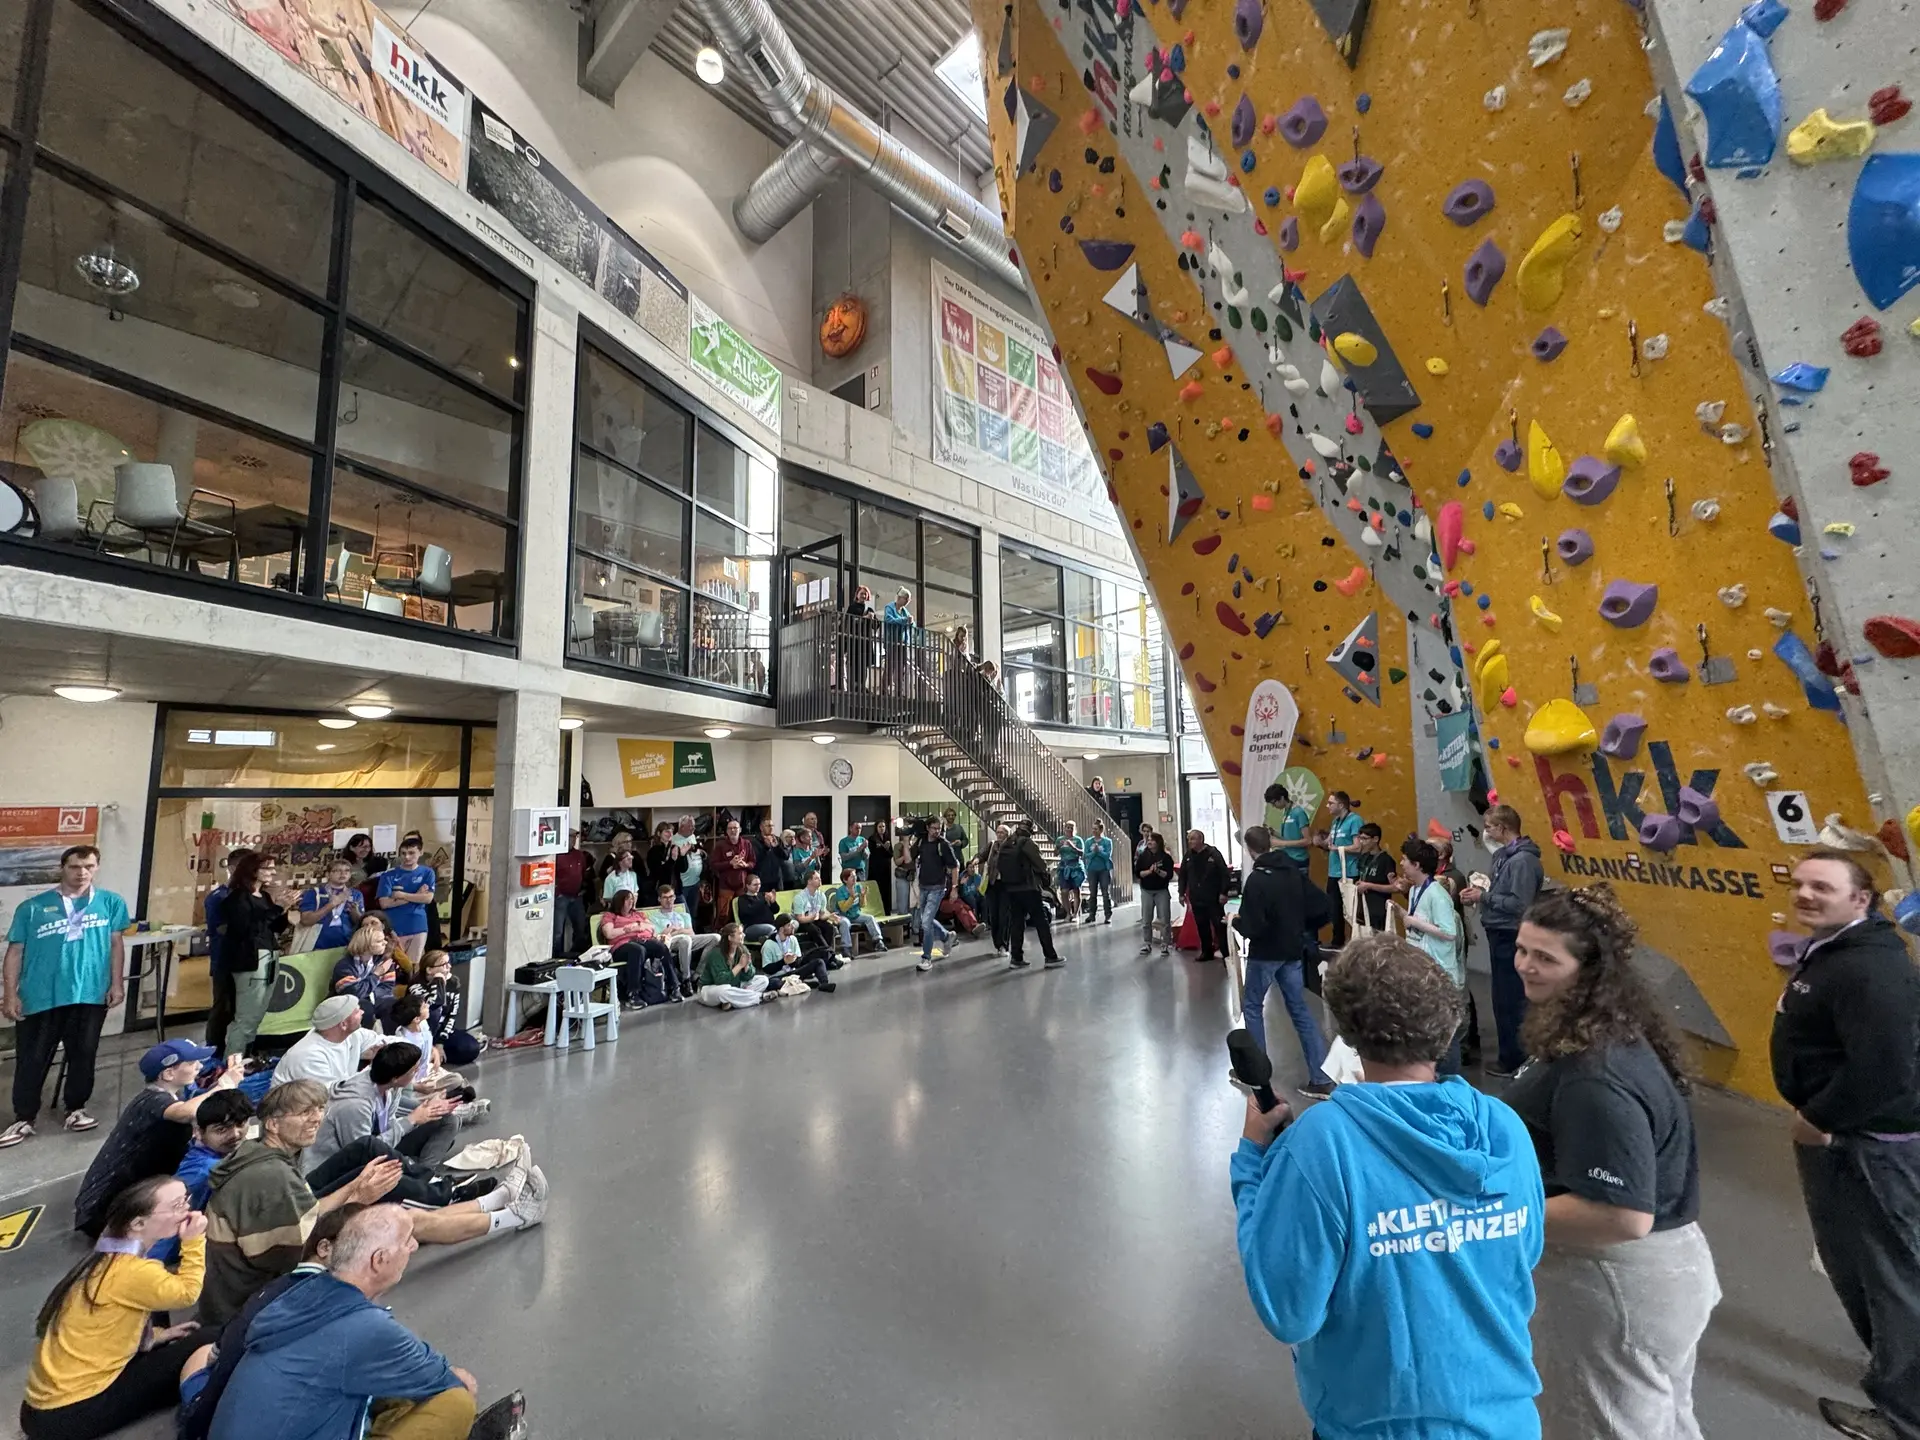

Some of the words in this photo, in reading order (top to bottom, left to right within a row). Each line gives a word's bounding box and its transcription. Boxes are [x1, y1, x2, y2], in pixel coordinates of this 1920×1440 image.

[390, 41, 449, 113] hkk
[389, 69, 449, 123] KRANKENKASSE
[422, 143, 448, 169] hkk.de
[502, 240, 534, 268] PRIEN
[955, 282, 967, 295] DAV
[967, 291, 989, 309] Bremen
[989, 306, 1014, 326] engagiert
[732, 352, 771, 391] Allez!
[953, 453, 968, 466] DAV
[1012, 476, 1031, 494] Was
[1032, 485, 1051, 503] tust
[1051, 496, 1067, 508] du?
[1252, 730, 1284, 743] Special
[1533, 741, 1748, 849] hkk
[1778, 795, 1803, 823] 6
[190, 855, 210, 872] in
[1560, 854, 1764, 899] KRANKENKASSE
[37, 913, 98, 933] #KLETRN
[1588, 1167, 1624, 1187] s.Oliver
[1369, 1234, 1421, 1257] OHNE
